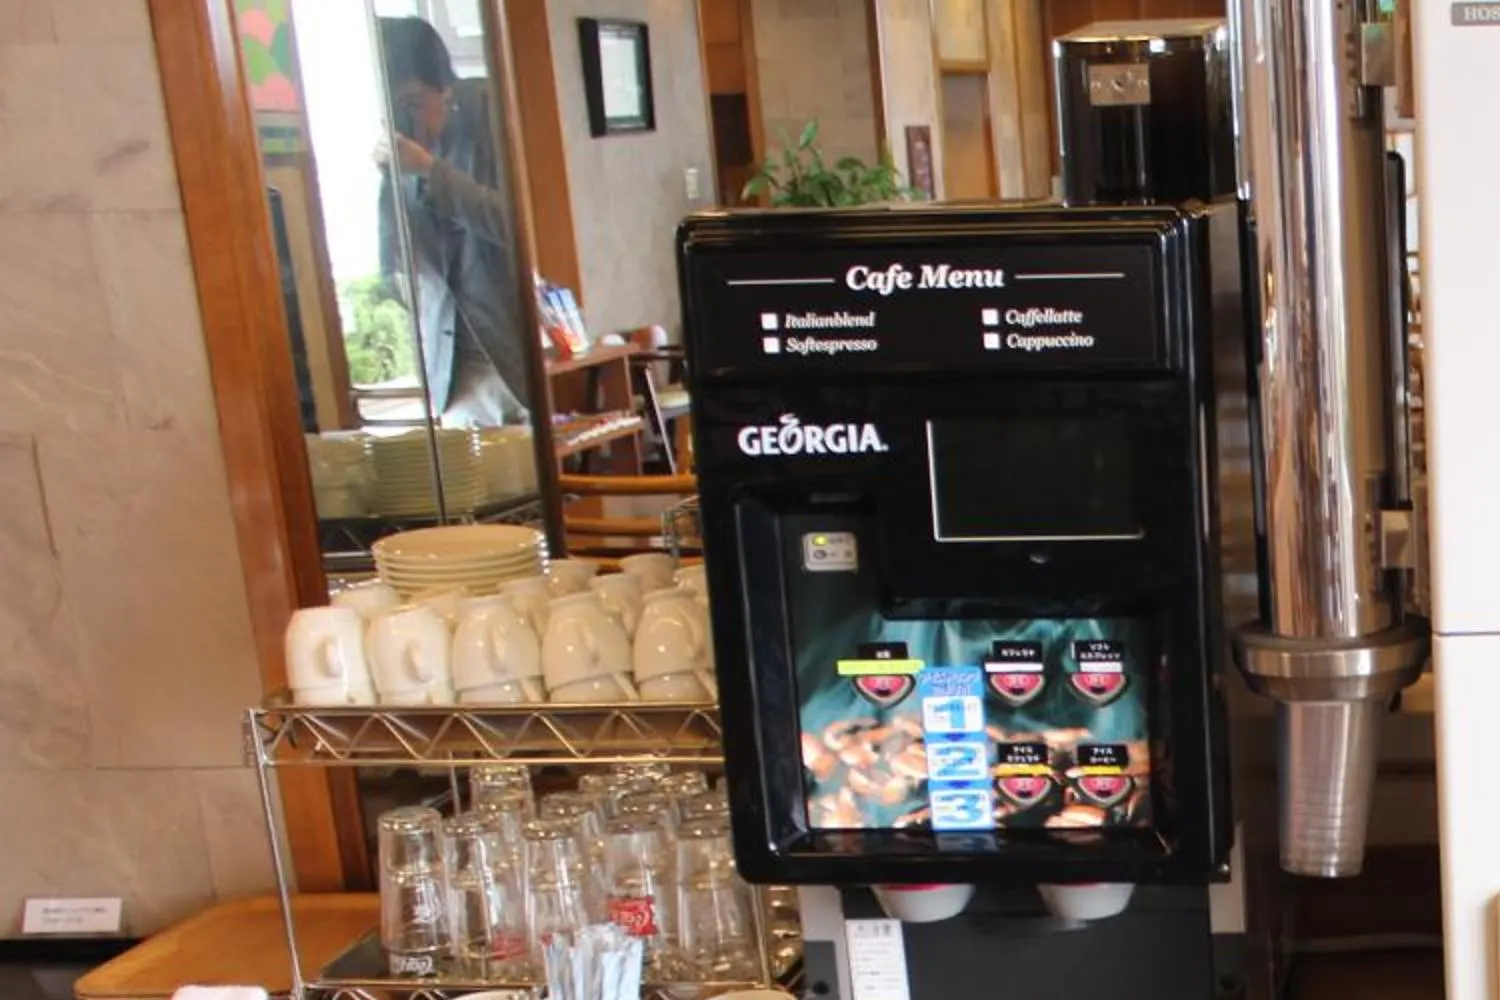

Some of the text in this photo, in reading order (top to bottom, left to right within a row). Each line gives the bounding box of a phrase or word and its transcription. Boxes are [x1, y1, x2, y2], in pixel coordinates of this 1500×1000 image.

[845, 263, 1005, 296] Cafe Menu
[785, 311, 876, 329] Italianblend
[786, 336, 878, 355] Softespresso
[1007, 331, 1095, 351] Cappuccino
[738, 413, 881, 456] GEORGIA
[933, 699, 965, 729] 1
[935, 745, 980, 776] 2
[937, 793, 984, 823] 3
